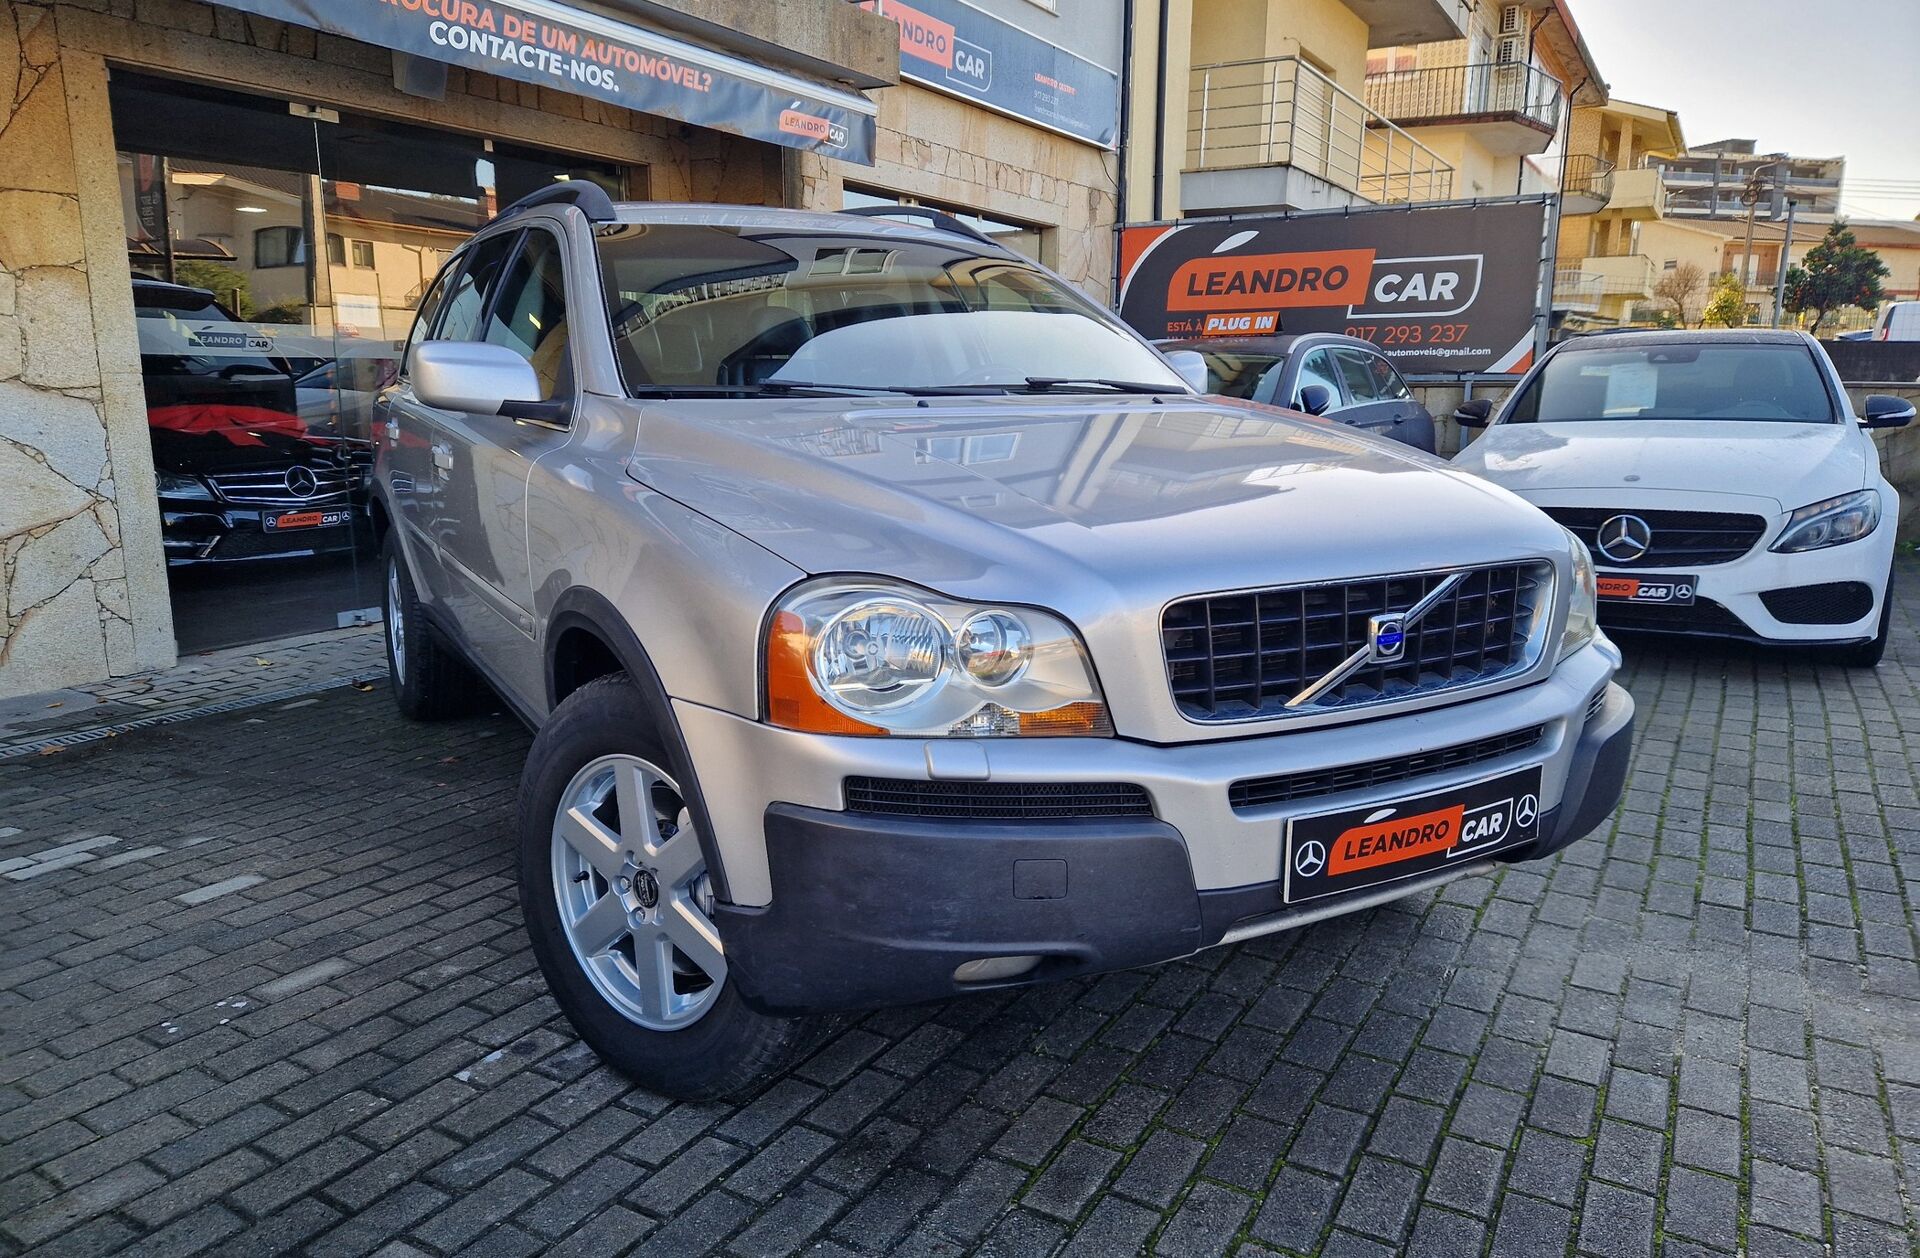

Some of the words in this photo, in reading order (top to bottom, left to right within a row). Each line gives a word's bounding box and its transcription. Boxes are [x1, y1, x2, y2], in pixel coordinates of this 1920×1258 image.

[379, 0, 496, 33] OCURA
[503, 14, 536, 44] DE
[541, 25, 577, 55] UM
[581, 38, 712, 92] AUTOMÓVEL?
[429, 20, 620, 92] CONTACTE-NOS.
[955, 50, 985, 80] CAR
[784, 115, 826, 134] LEANDRO
[829, 128, 845, 143] CAR
[1187, 265, 1349, 297] LEANDRO
[1374, 271, 1459, 303] CAR
[1167, 318, 1192, 332] ESTÁ
[1207, 318, 1250, 331] PLUG
[1254, 316, 1274, 330] IN
[1345, 327, 1377, 342] 917
[1383, 325, 1422, 343] 293
[1428, 324, 1469, 343] 237
[248, 340, 269, 348] CAR
[282, 515, 318, 524] LEANDRO
[322, 515, 338, 523] CAR
[1597, 583, 1630, 591] NDRO
[1638, 587, 1667, 597] CAR
[1461, 812, 1503, 843] CAR
[1344, 819, 1449, 861] LEANDRO
